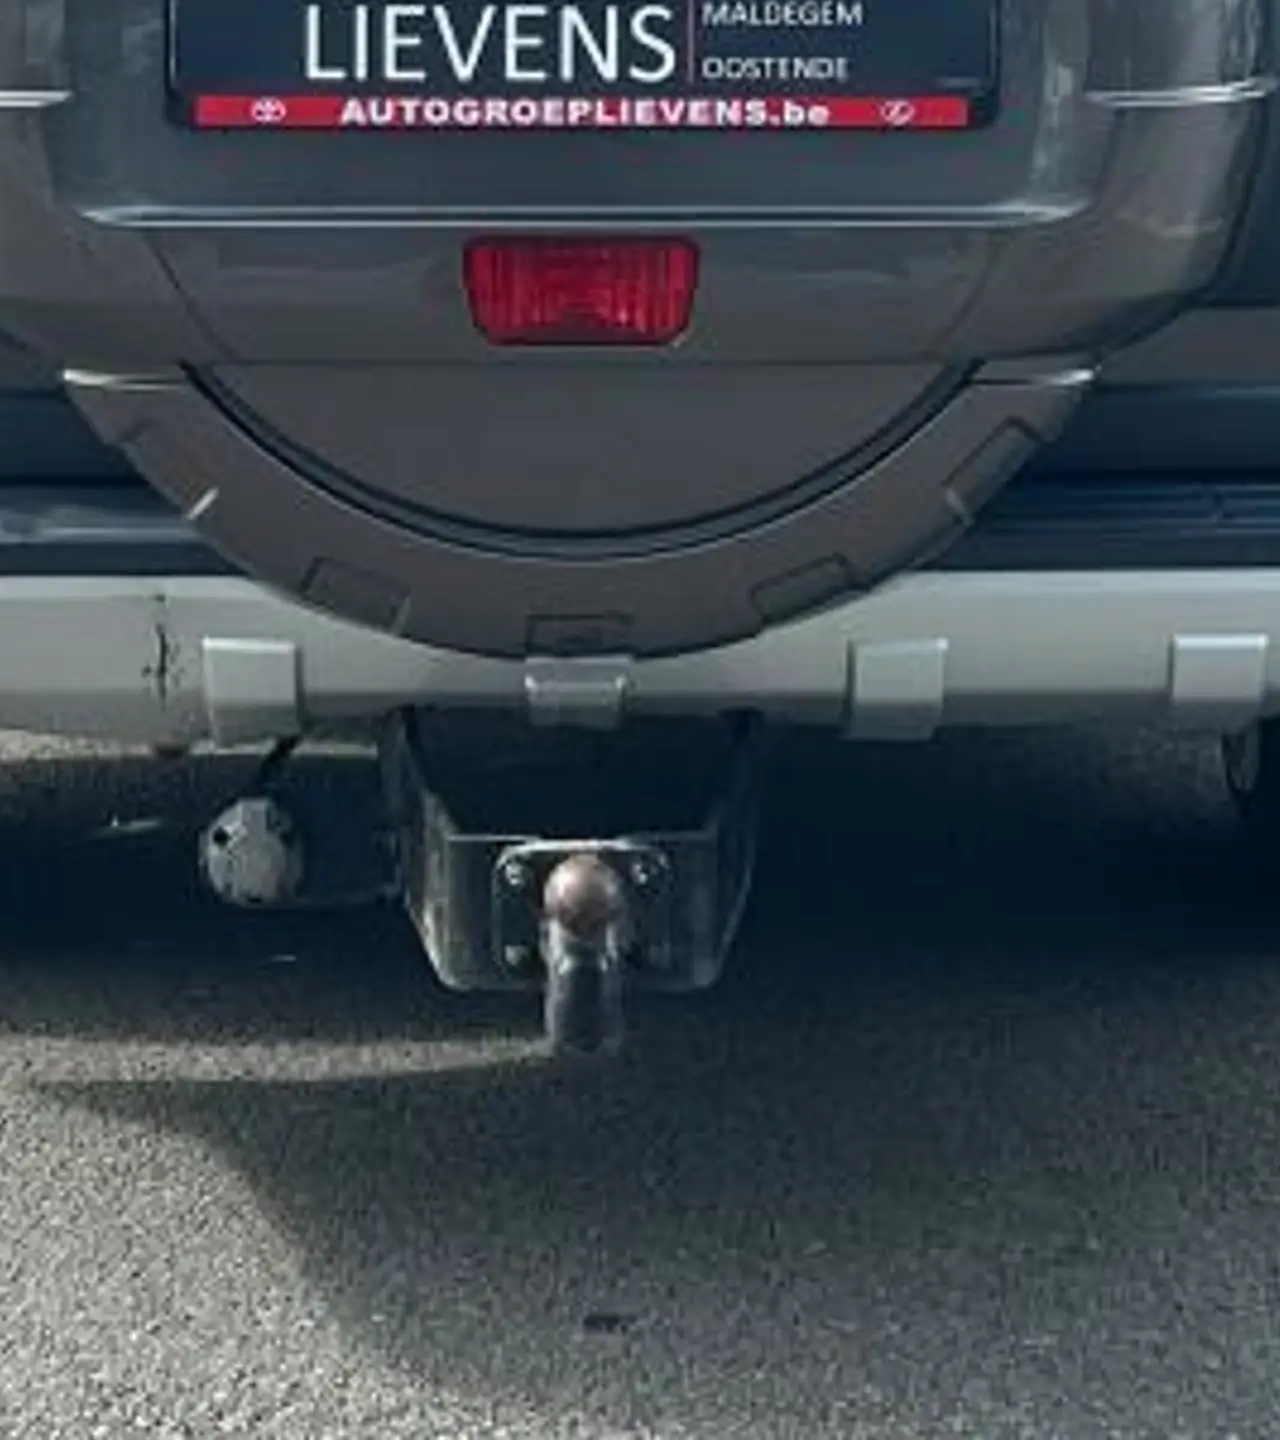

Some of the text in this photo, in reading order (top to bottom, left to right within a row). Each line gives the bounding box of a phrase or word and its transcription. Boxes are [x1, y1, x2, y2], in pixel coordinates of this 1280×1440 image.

[701, 0, 864, 27] MALDEGEM
[305, 3, 677, 83] LIEVENS
[701, 57, 850, 82] OOSTENDE
[338, 97, 831, 126] AUTOGROEPLIEVENS.be
